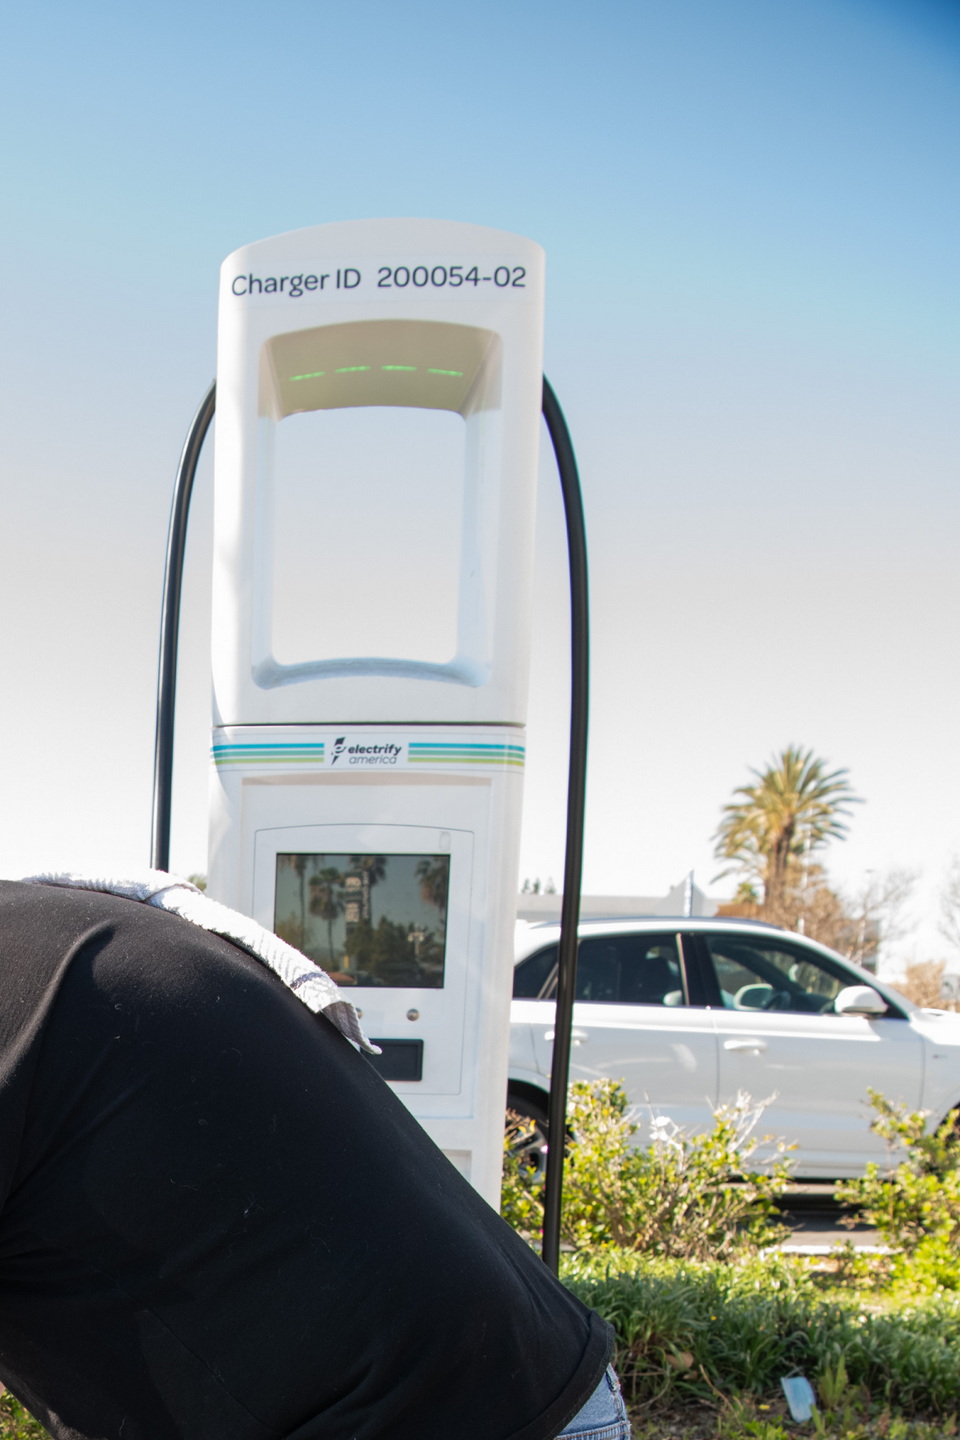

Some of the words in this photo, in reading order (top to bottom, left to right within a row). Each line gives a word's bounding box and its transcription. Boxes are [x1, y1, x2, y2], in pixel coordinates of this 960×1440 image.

[231, 269, 330, 297] Charger
[336, 268, 362, 290] ID
[377, 266, 527, 288] 200054-02
[348, 744, 402, 757] electrify
[349, 755, 398, 765] america
